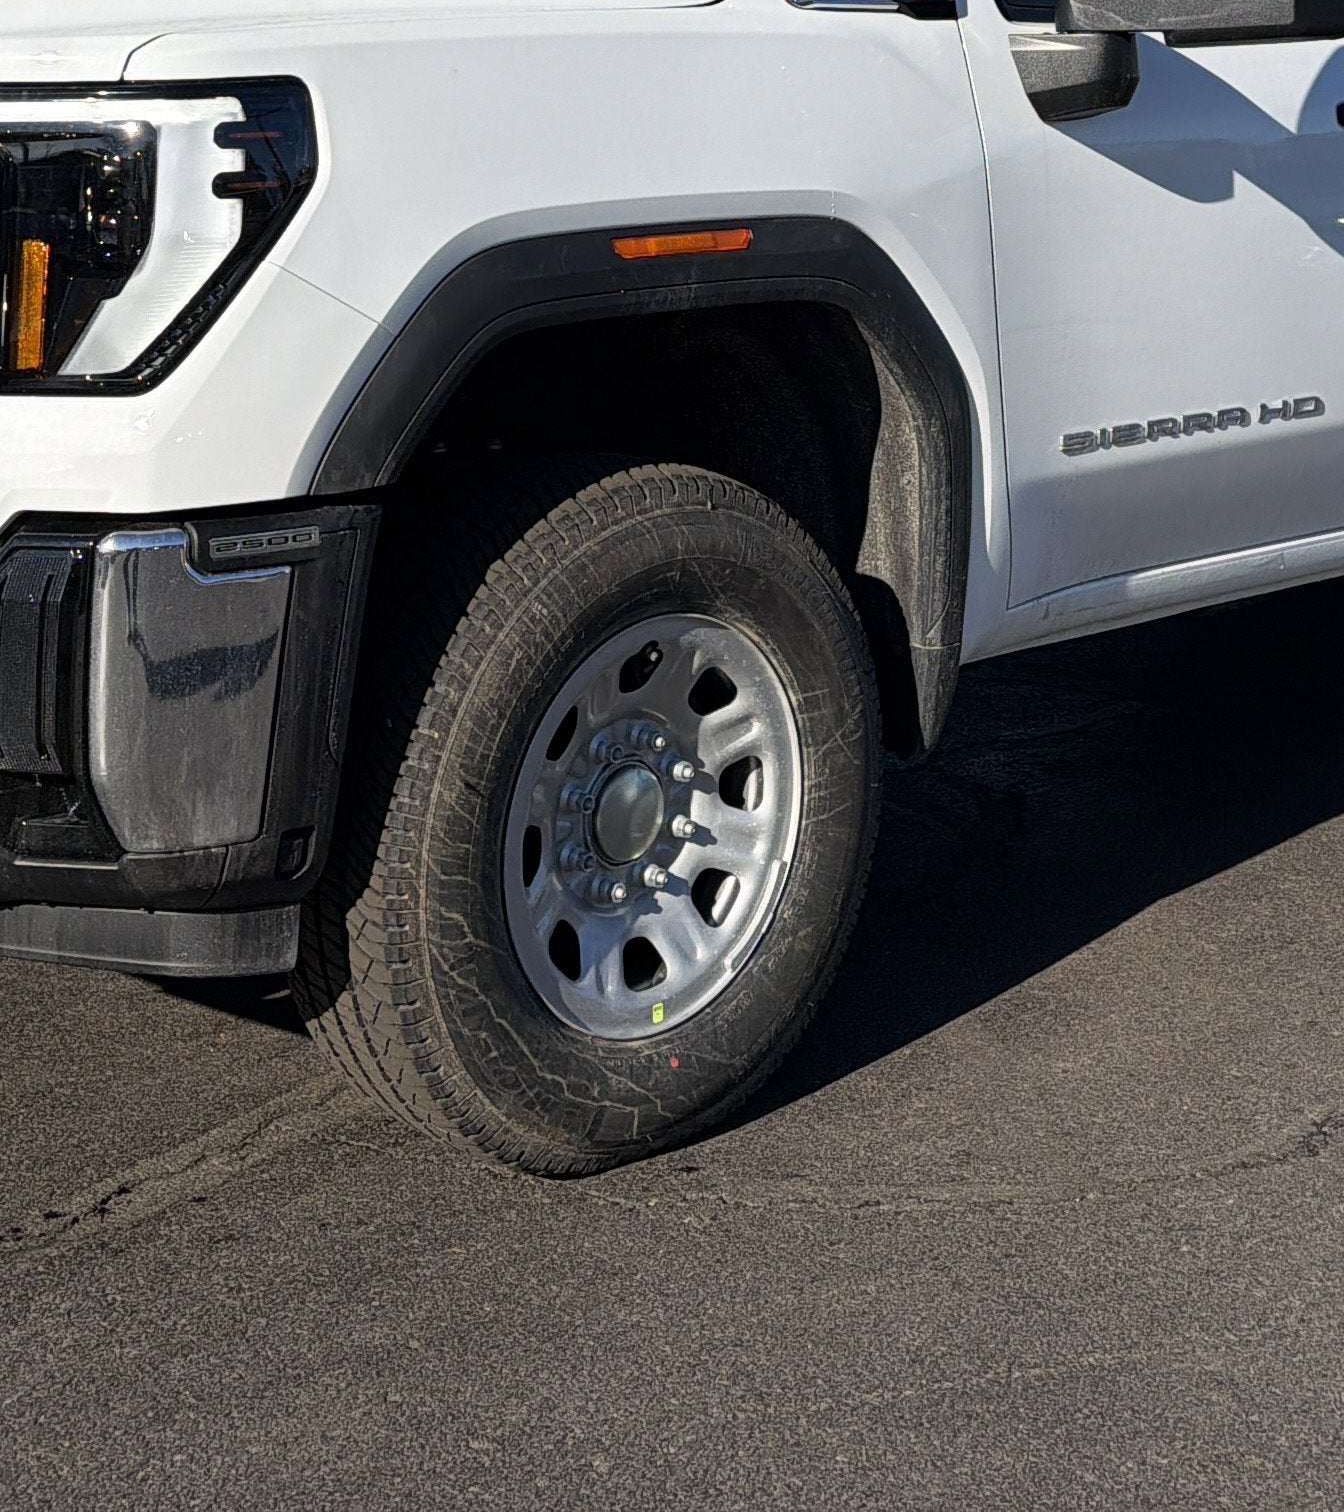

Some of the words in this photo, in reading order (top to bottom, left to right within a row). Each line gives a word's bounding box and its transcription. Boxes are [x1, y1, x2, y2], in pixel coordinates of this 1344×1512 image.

[1058, 406, 1252, 457] SIERRA
[1257, 395, 1326, 424] HD
[214, 532, 315, 553] 2500
